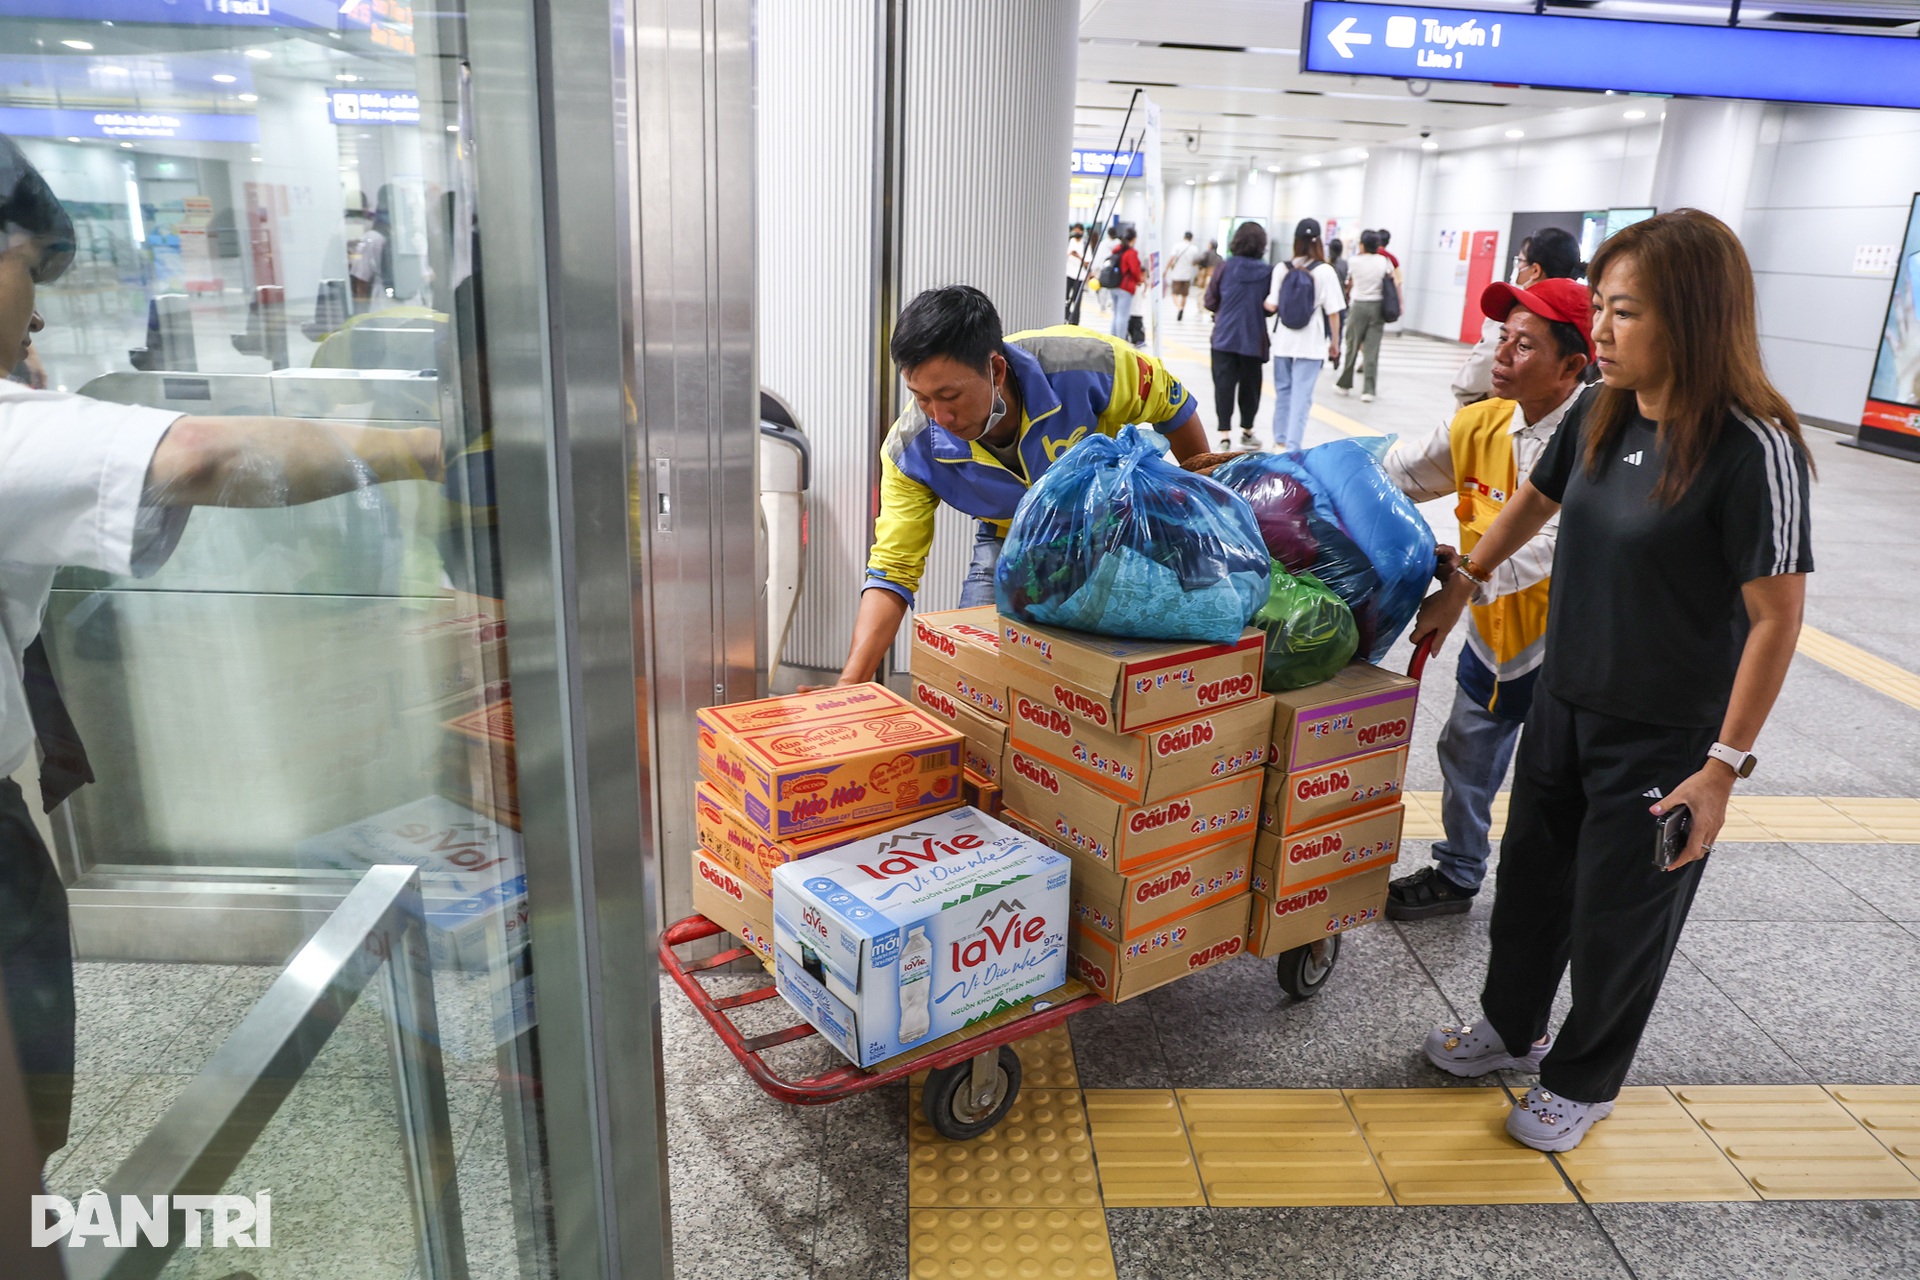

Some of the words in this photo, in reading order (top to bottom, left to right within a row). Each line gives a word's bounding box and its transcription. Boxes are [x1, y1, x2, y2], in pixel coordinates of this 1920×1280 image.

[1490, 23, 1502, 47] 1
[1417, 49, 1453, 68] Line
[1455, 51, 1464, 69] 1
[1172, 667, 1195, 684] Tôm
[1072, 744, 1088, 763] Gà
[1111, 759, 1136, 782] Phở
[1210, 760, 1226, 777] Gà
[1245, 745, 1265, 764] Phở
[791, 793, 828, 822] Hảo
[830, 780, 866, 809] Hảo
[1055, 818, 1068, 837] Gà
[1190, 818, 1206, 835] Gà
[1230, 805, 1251, 823] Phở
[1342, 850, 1357, 864] Gà
[1190, 883, 1205, 899] Gà
[1225, 865, 1245, 885] Phở
[803, 907, 827, 937] laVie
[1326, 919, 1340, 932] Gà
[952, 913, 1046, 972] laVie
